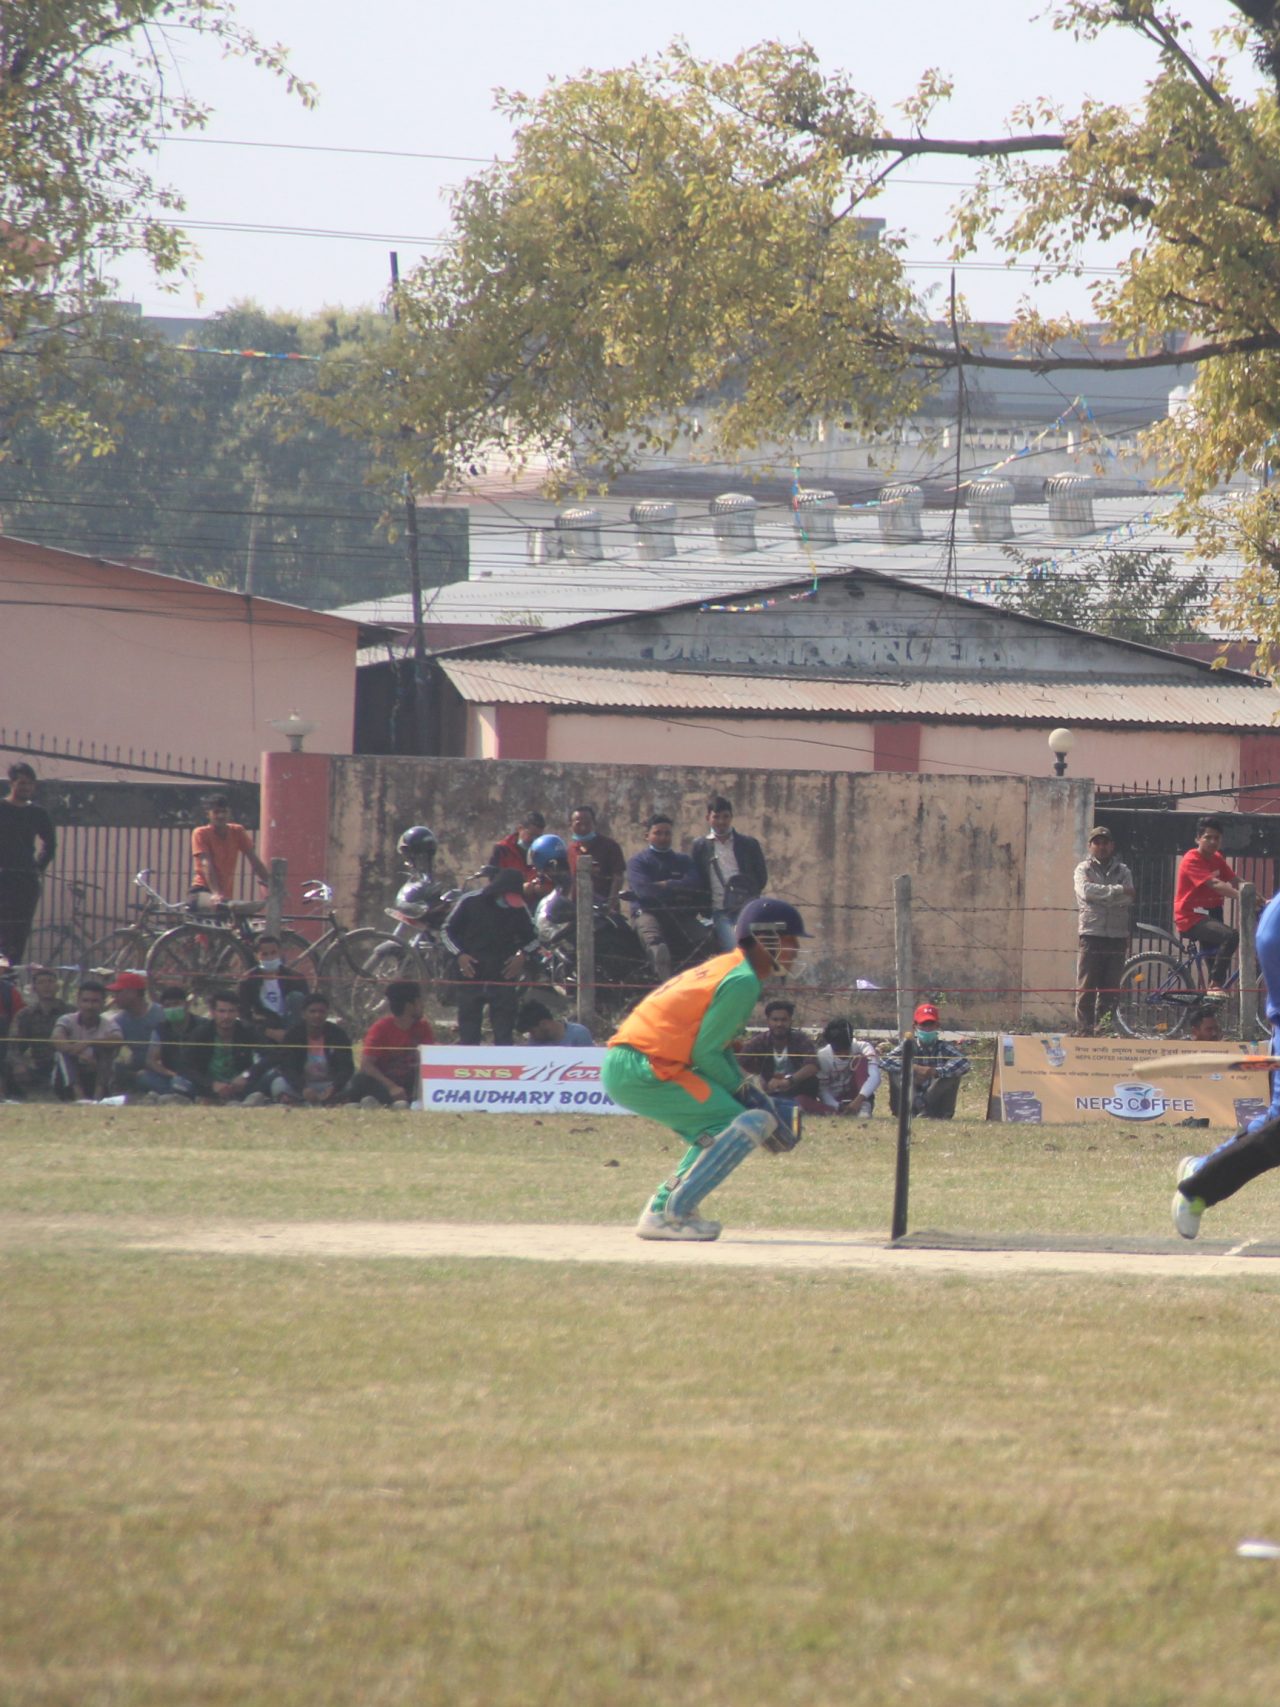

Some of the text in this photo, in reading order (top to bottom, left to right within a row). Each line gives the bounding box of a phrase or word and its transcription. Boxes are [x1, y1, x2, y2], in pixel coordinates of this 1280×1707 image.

[453, 1067, 513, 1079] SNS
[431, 1088, 554, 1105] CHAUDHARY
[1076, 1097, 1195, 1112] NEPS COFFEE
